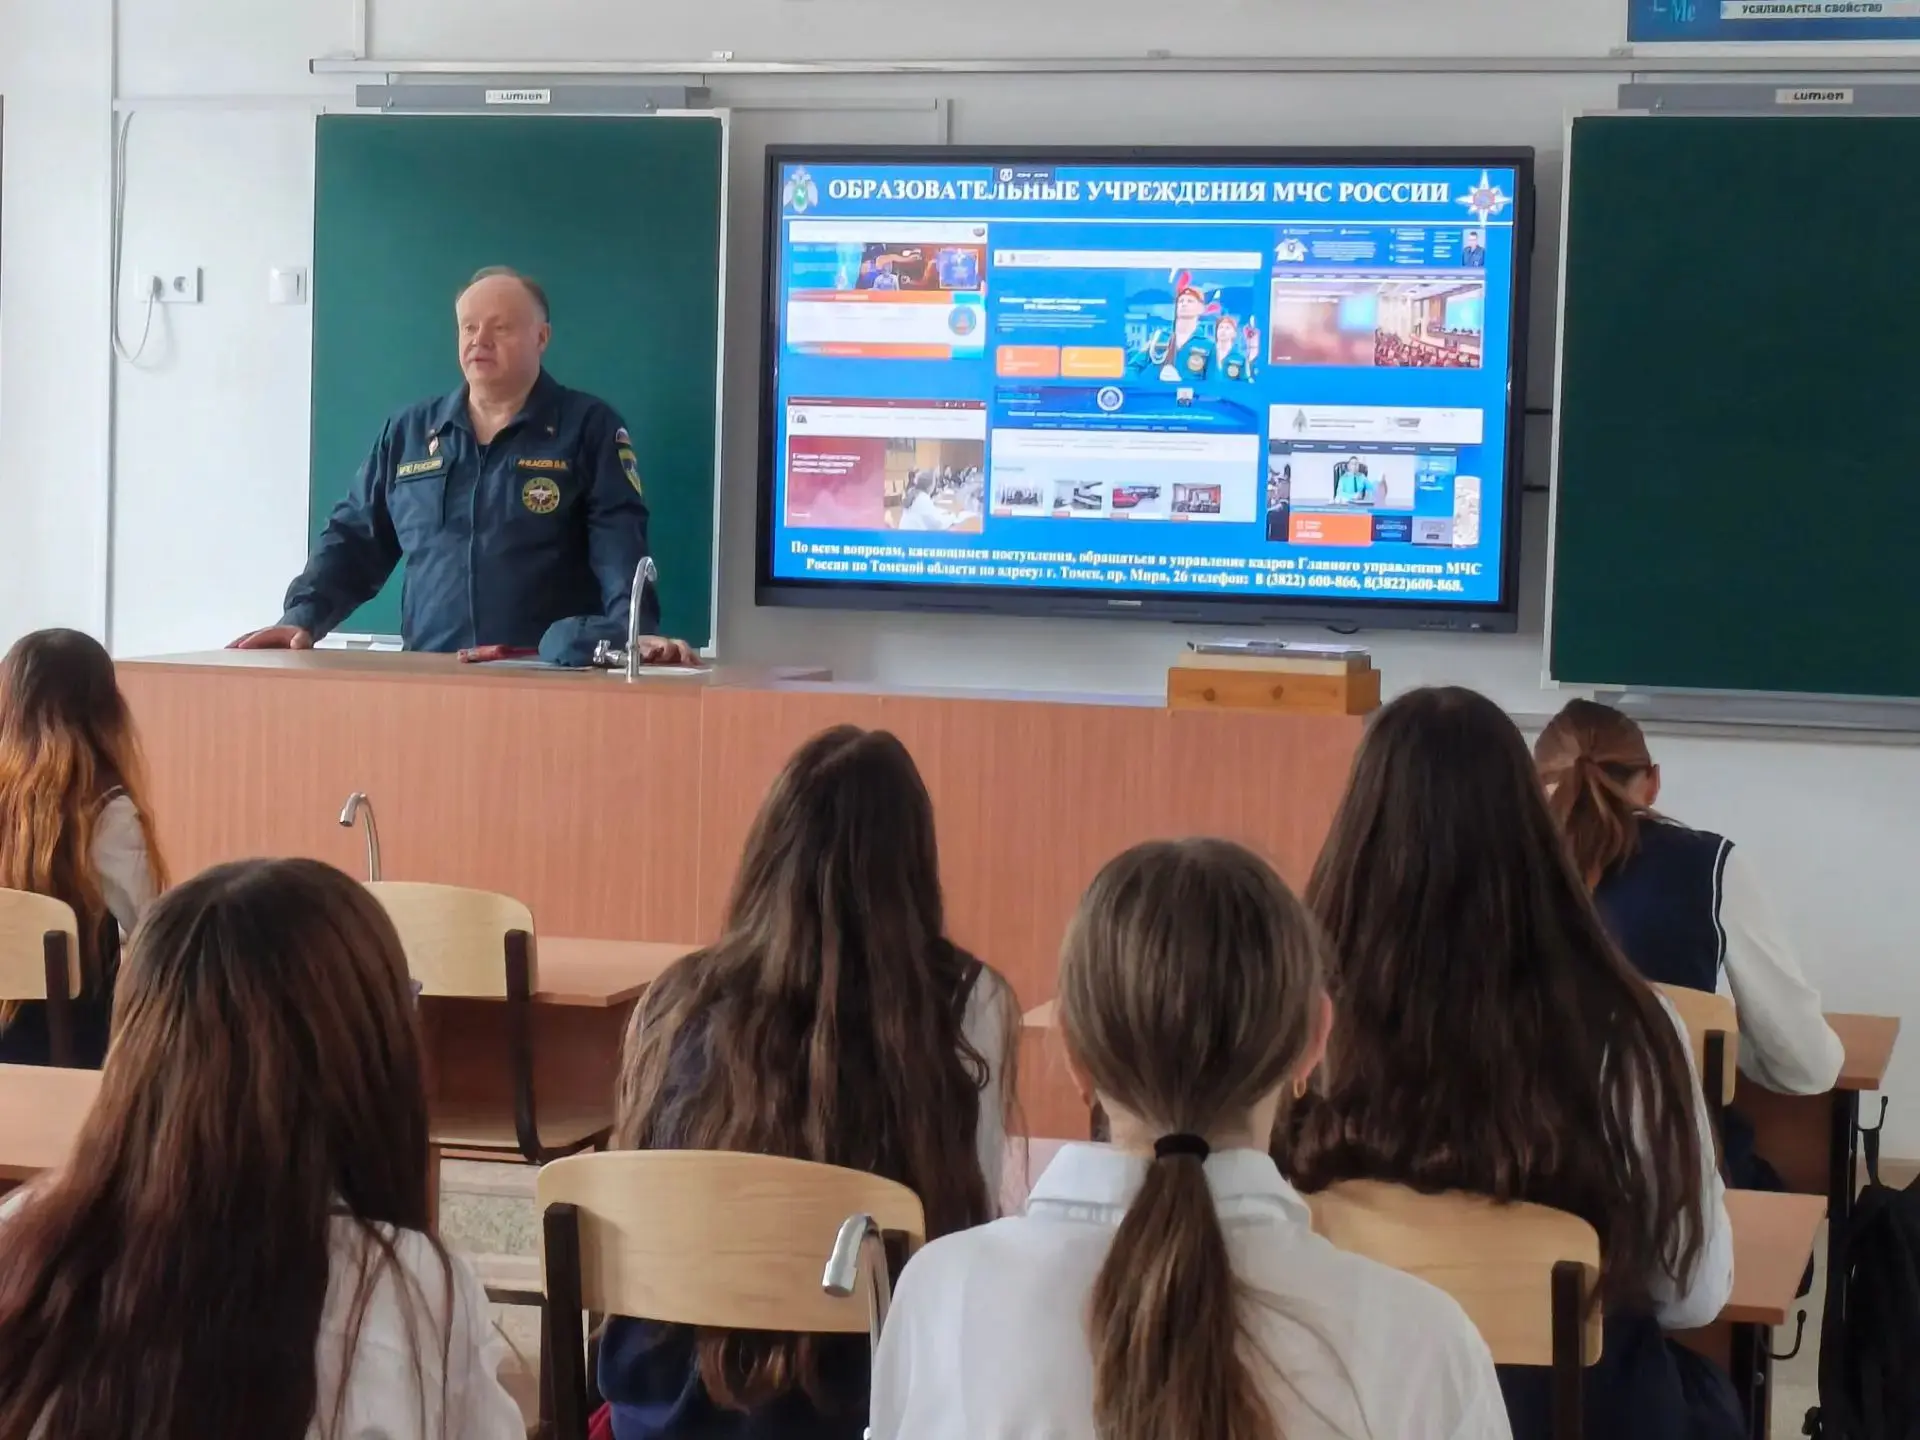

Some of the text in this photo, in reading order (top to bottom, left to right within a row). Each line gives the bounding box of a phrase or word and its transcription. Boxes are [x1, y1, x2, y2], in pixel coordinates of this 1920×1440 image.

[1742, 2, 1883, 15] УСИЛИВАЕТСЯ СВОЙСТВО
[828, 179, 1449, 204] ОБРАЗОВАТЕЛЬНЫЕ УЧРЕЖДЕНИЯ МЧС РОССИИ
[791, 540, 808, 553] По
[811, 544, 840, 554] всем
[844, 545, 905, 559] вопросам,
[909, 546, 989, 559] касающимся
[992, 549, 1076, 564] поступления,
[1079, 549, 1155, 565] обращаться
[1159, 555, 1167, 565] в
[1170, 555, 1245, 569] управление
[1248, 557, 1294, 571] кадров
[1297, 556, 1360, 571] Главного
[1446, 562, 1482, 576] МЧС
[806, 558, 848, 571] России
[852, 562, 867, 572] по
[870, 559, 924, 574] Томской
[927, 563, 975, 575] области
[980, 566, 994, 577] по
[998, 566, 1043, 580] адресу:
[1046, 568, 1056, 579] г.
[1060, 566, 1103, 582] Томск,
[1106, 571, 1126, 583] пр.
[1130, 569, 1170, 584] Мира,
[1173, 570, 1187, 583] 26
[1191, 571, 1249, 587] телефон:
[1255, 573, 1263, 585] 8
[1267, 572, 1305, 587] (3822)
[1308, 575, 1361, 589] 600-866,
